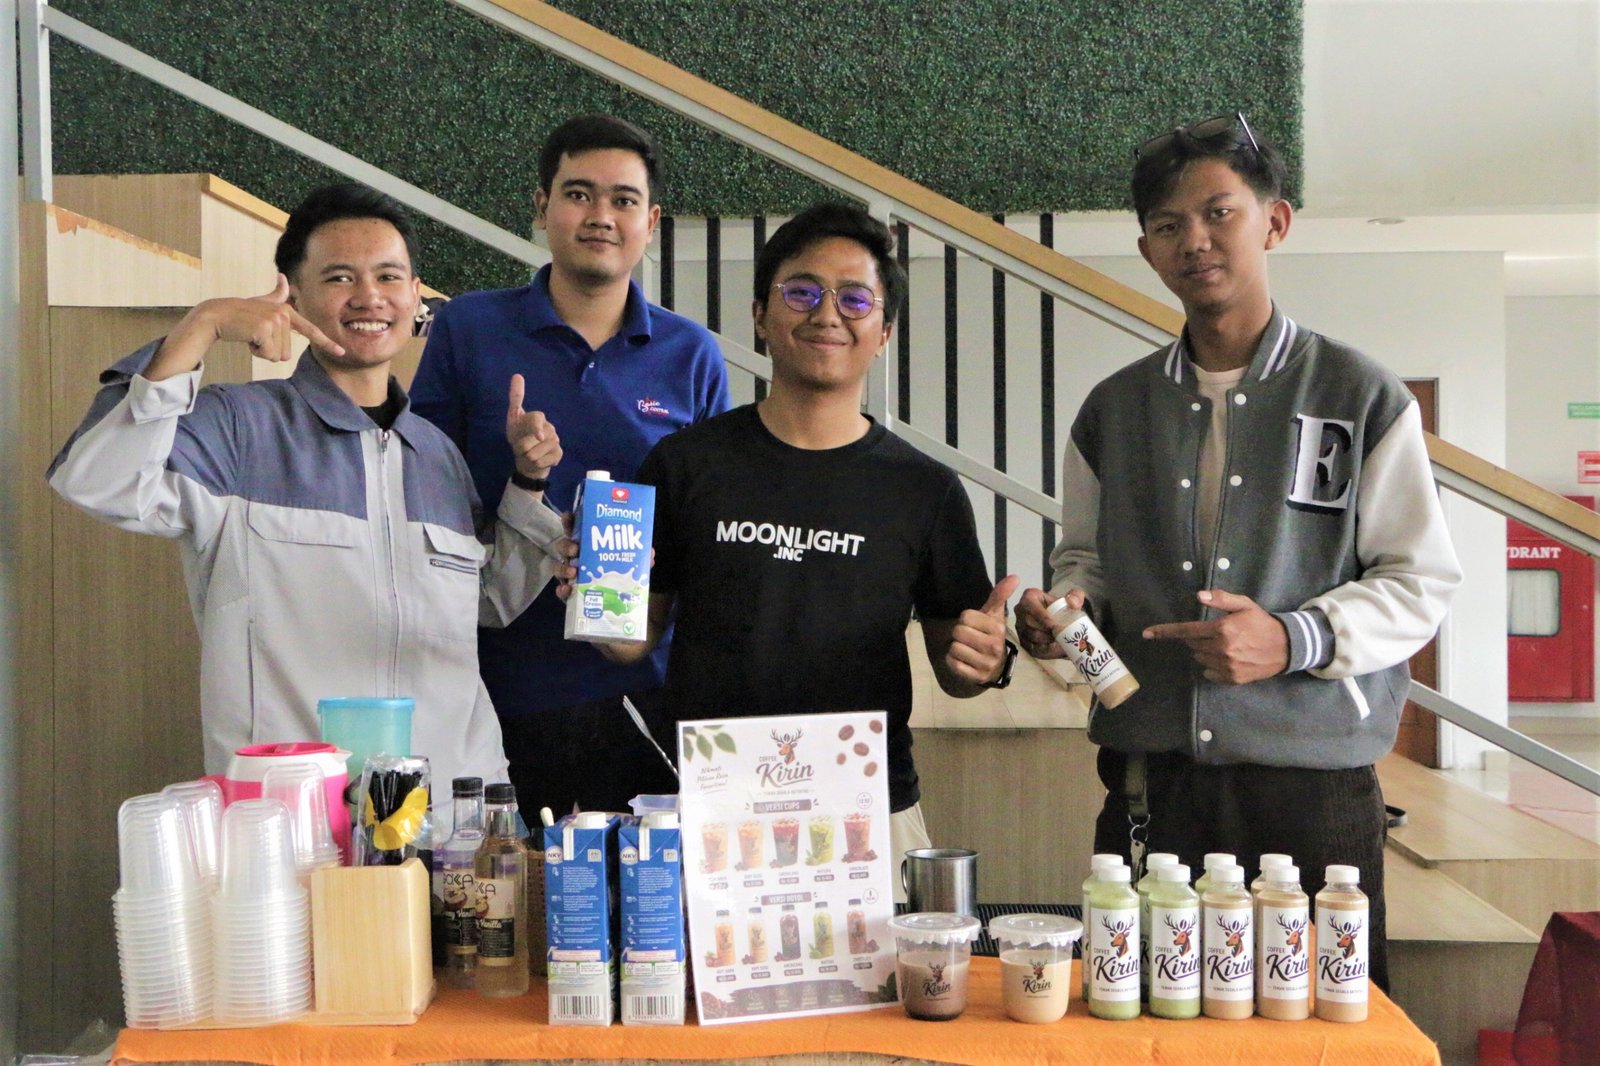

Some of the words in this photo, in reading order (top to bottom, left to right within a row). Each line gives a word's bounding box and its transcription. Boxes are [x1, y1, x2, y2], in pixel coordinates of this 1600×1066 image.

[1287, 412, 1354, 511] E
[597, 504, 642, 522] Diamond
[591, 524, 643, 551] Milk
[716, 521, 865, 556] MOONLIGHT
[598, 552, 621, 562] 100%
[773, 546, 804, 562] .INC
[1507, 546, 1561, 559] DRANT
[1079, 649, 1115, 682] Kirin
[756, 761, 815, 788] Kirin
[784, 802, 800, 810] CUPS
[1208, 947, 1225, 955] COFFEE
[1320, 947, 1336, 956] COFFEE
[1093, 955, 1139, 983] Kirin
[1155, 954, 1200, 981] Kirin
[1207, 954, 1253, 983] Kirin
[1319, 955, 1366, 984] Kirin
[922, 981, 953, 997] Kirin
[1022, 979, 1053, 994] Kirin
